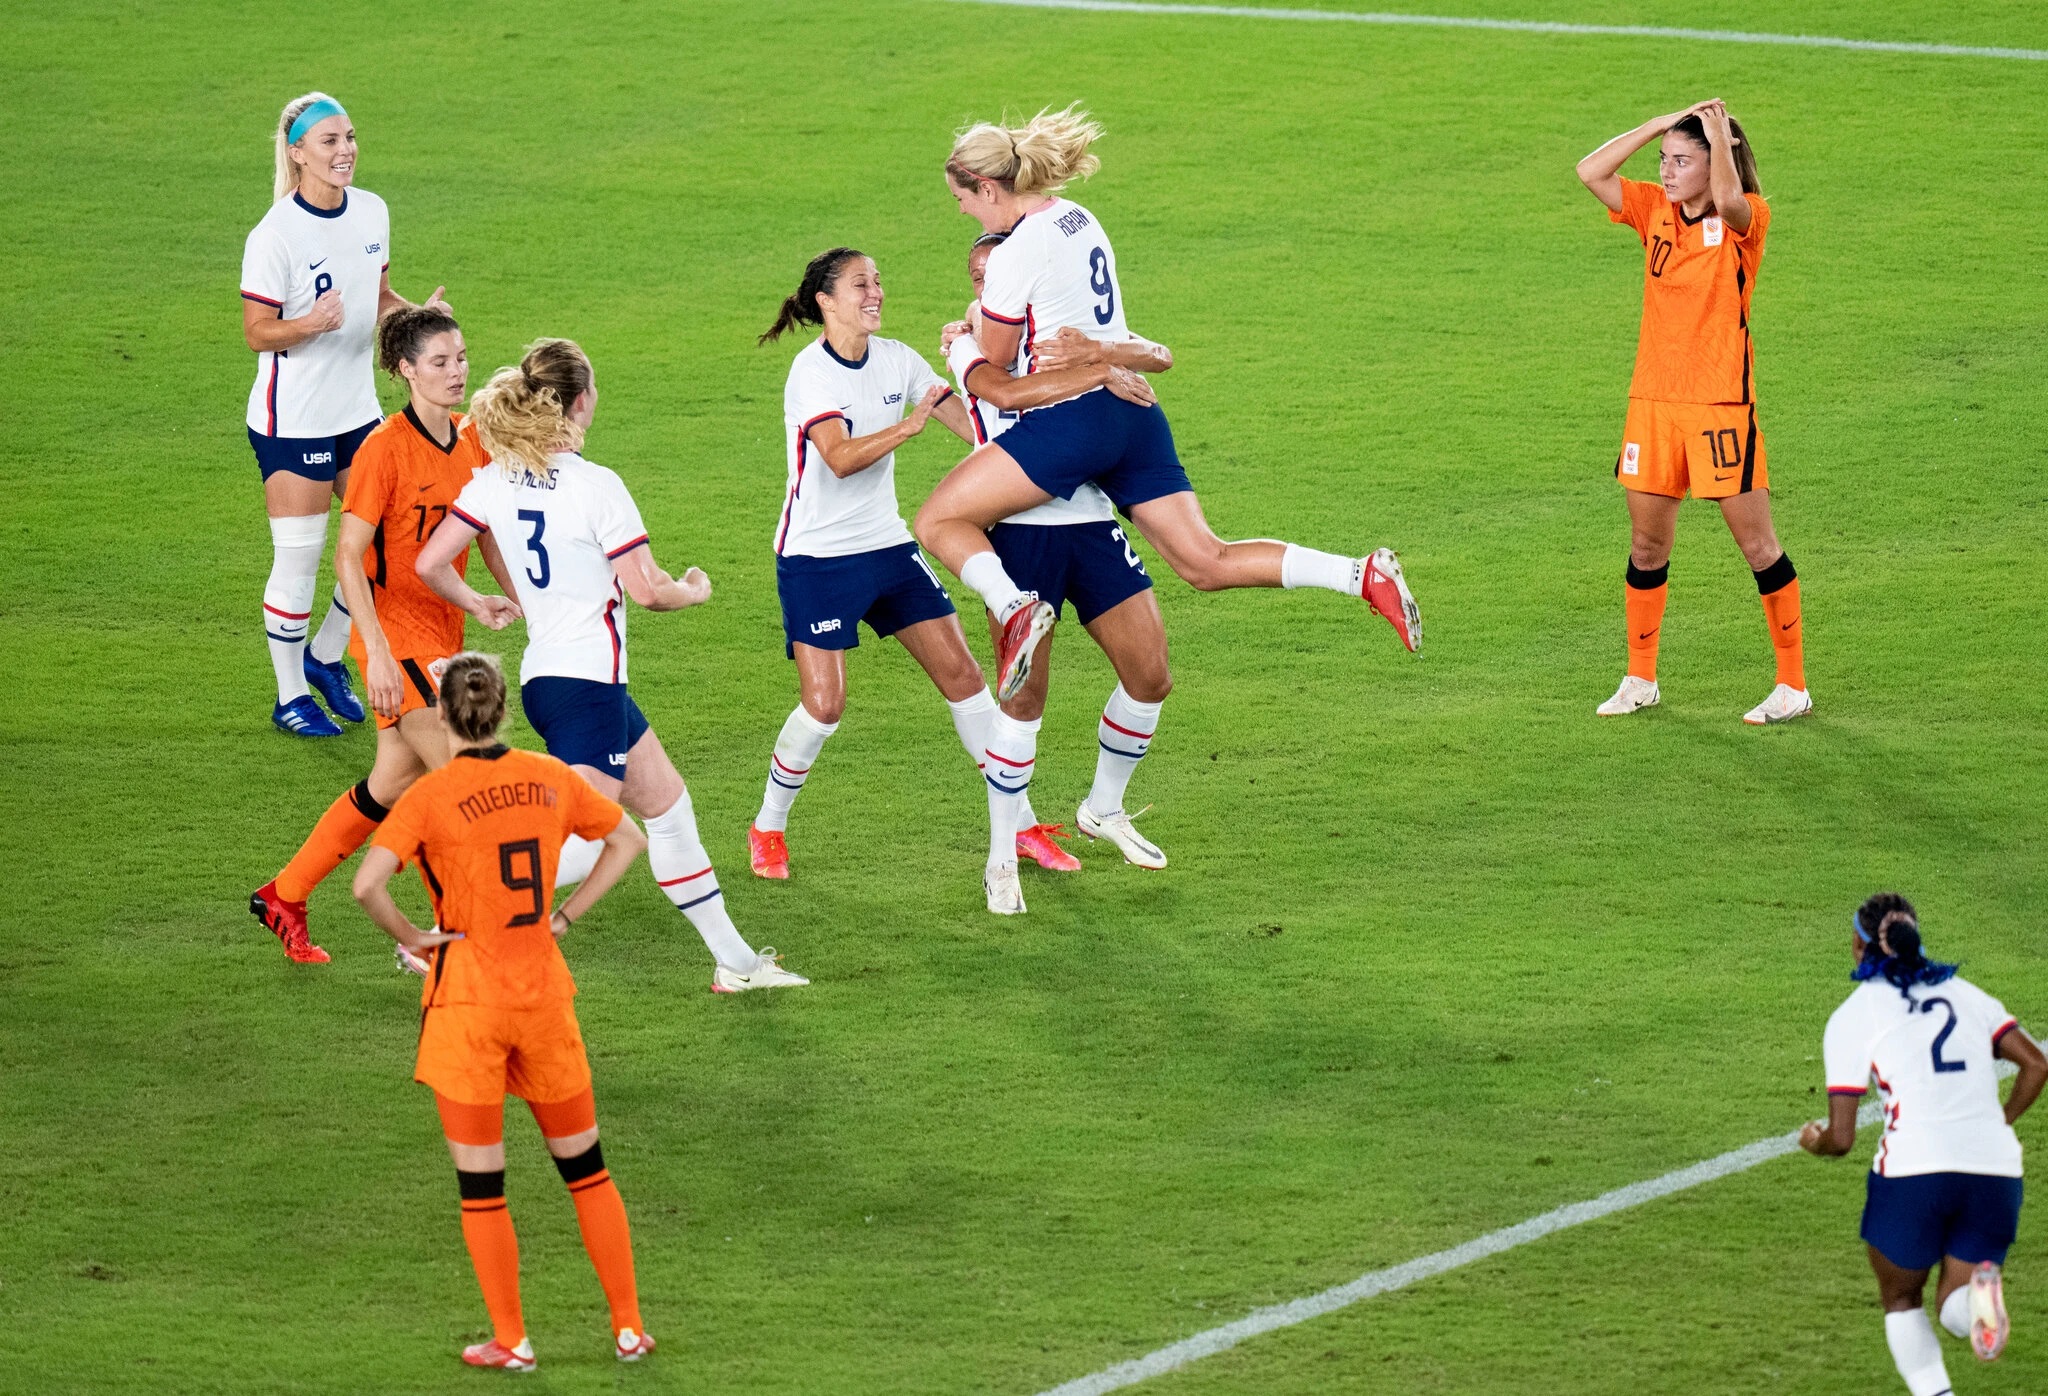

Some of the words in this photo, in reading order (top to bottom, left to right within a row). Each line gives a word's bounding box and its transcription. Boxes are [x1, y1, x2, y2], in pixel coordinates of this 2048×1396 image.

[1053, 207, 1090, 237] HORAN
[365, 243, 381, 254] USA
[1650, 234, 1673, 278] 10
[1089, 246, 1114, 326] 9
[303, 451, 332, 465] USA
[1701, 428, 1742, 469] 10
[413, 504, 448, 543] 17
[518, 509, 550, 589] 3
[810, 618, 842, 634] USA
[608, 753, 628, 766] US
[458, 782, 557, 824] MIEDEMA
[499, 837, 544, 928] 9
[1921, 996, 1967, 1073] 2
